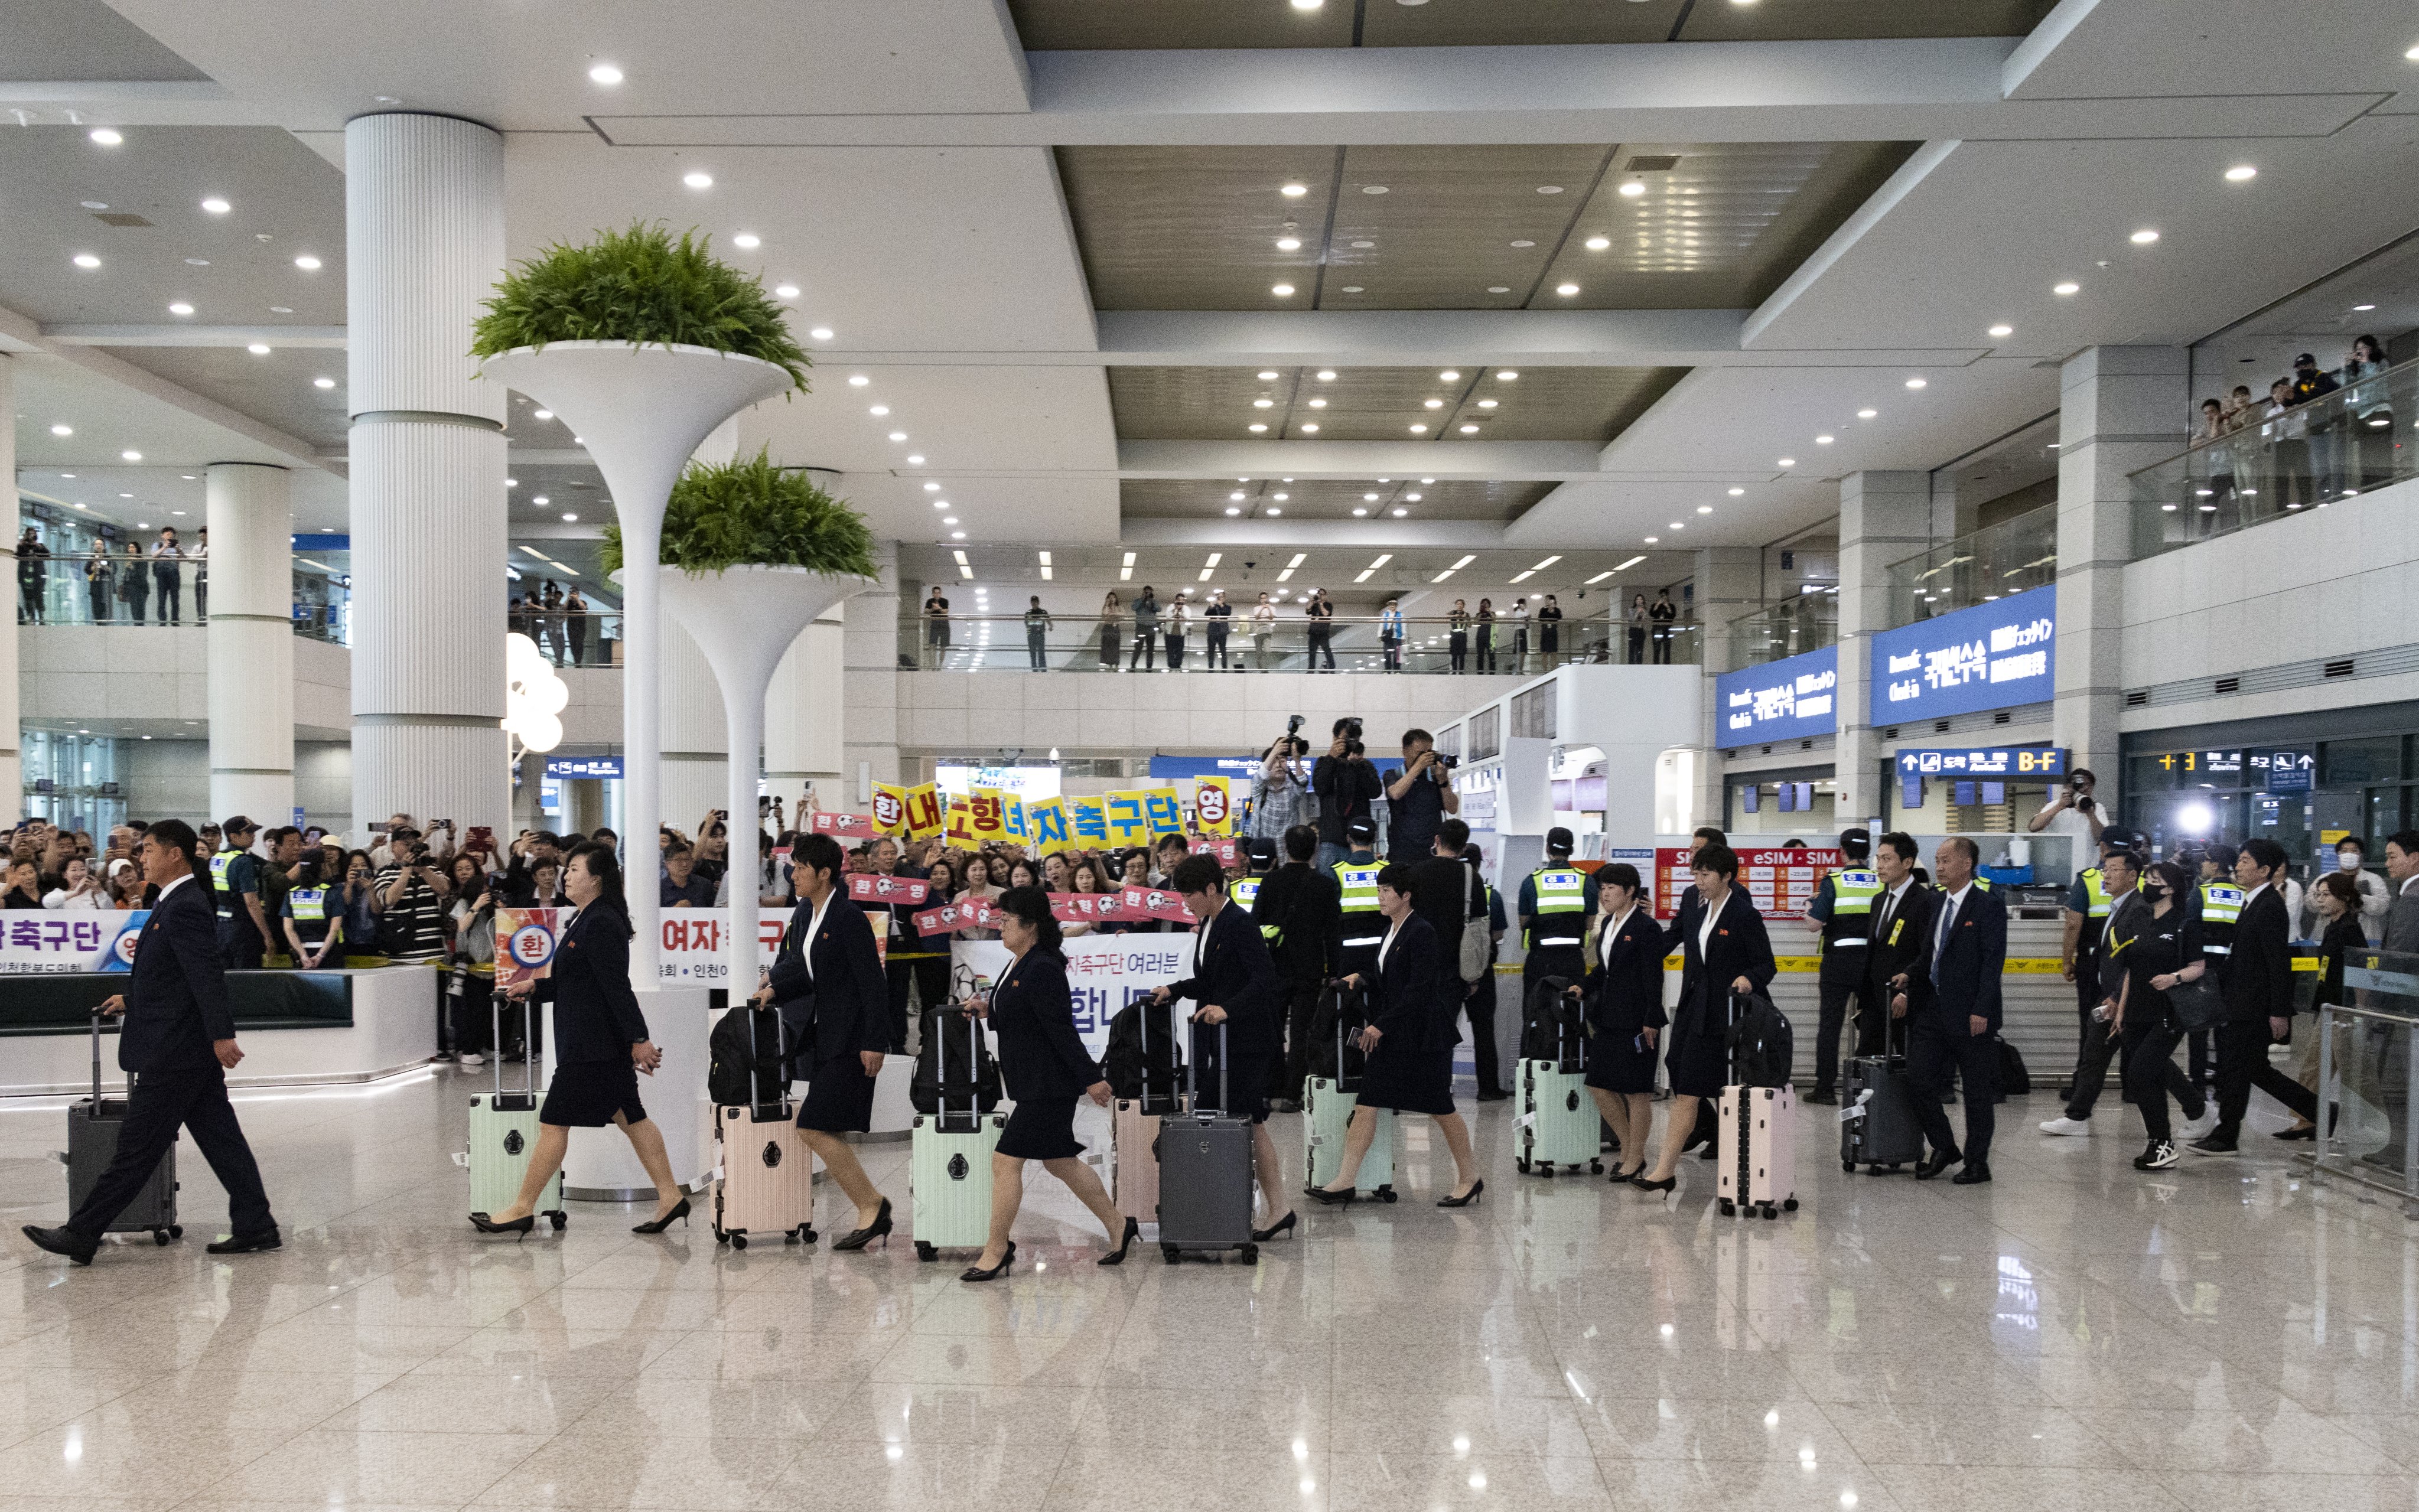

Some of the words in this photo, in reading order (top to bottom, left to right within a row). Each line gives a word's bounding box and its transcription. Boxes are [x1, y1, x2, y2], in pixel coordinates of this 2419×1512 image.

[2018, 752, 2056, 771] B-F
[875, 796, 900, 824] 환
[1199, 790, 1223, 820] 영
[1754, 852, 1793, 864] eSIM
[1806, 852, 1836, 865] SIM
[856, 879, 871, 894] 환
[910, 884, 924, 898] 영
[1126, 891, 1141, 907] 환
[922, 915, 937, 929] 환
[11, 920, 101, 951] 축구단
[663, 920, 720, 951] 여자
[522, 935, 544, 957] 환
[1128, 953, 1180, 975] 여러분
